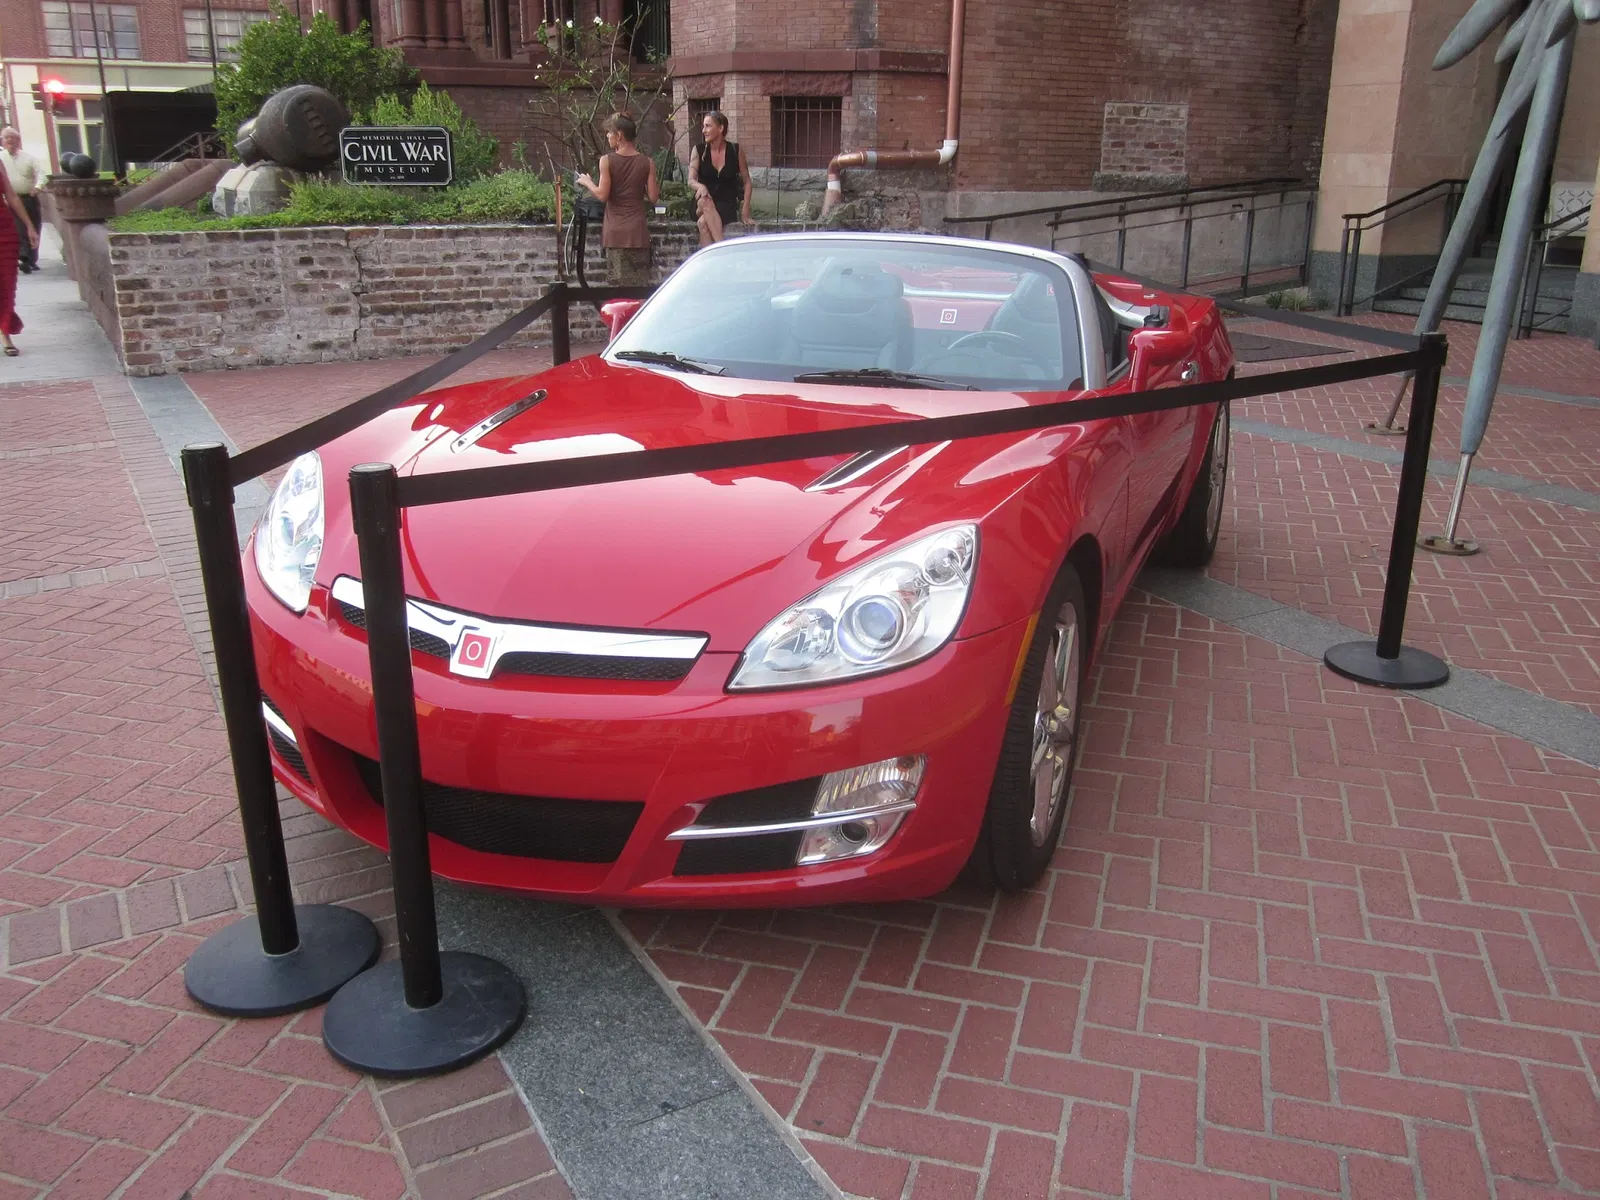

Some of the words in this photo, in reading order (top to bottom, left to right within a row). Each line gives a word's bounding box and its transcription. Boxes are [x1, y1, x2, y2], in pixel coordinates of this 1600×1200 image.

[344, 142, 398, 162] CIVIL
[400, 142, 447, 161] WAR
[364, 166, 430, 174] MUSEUM
